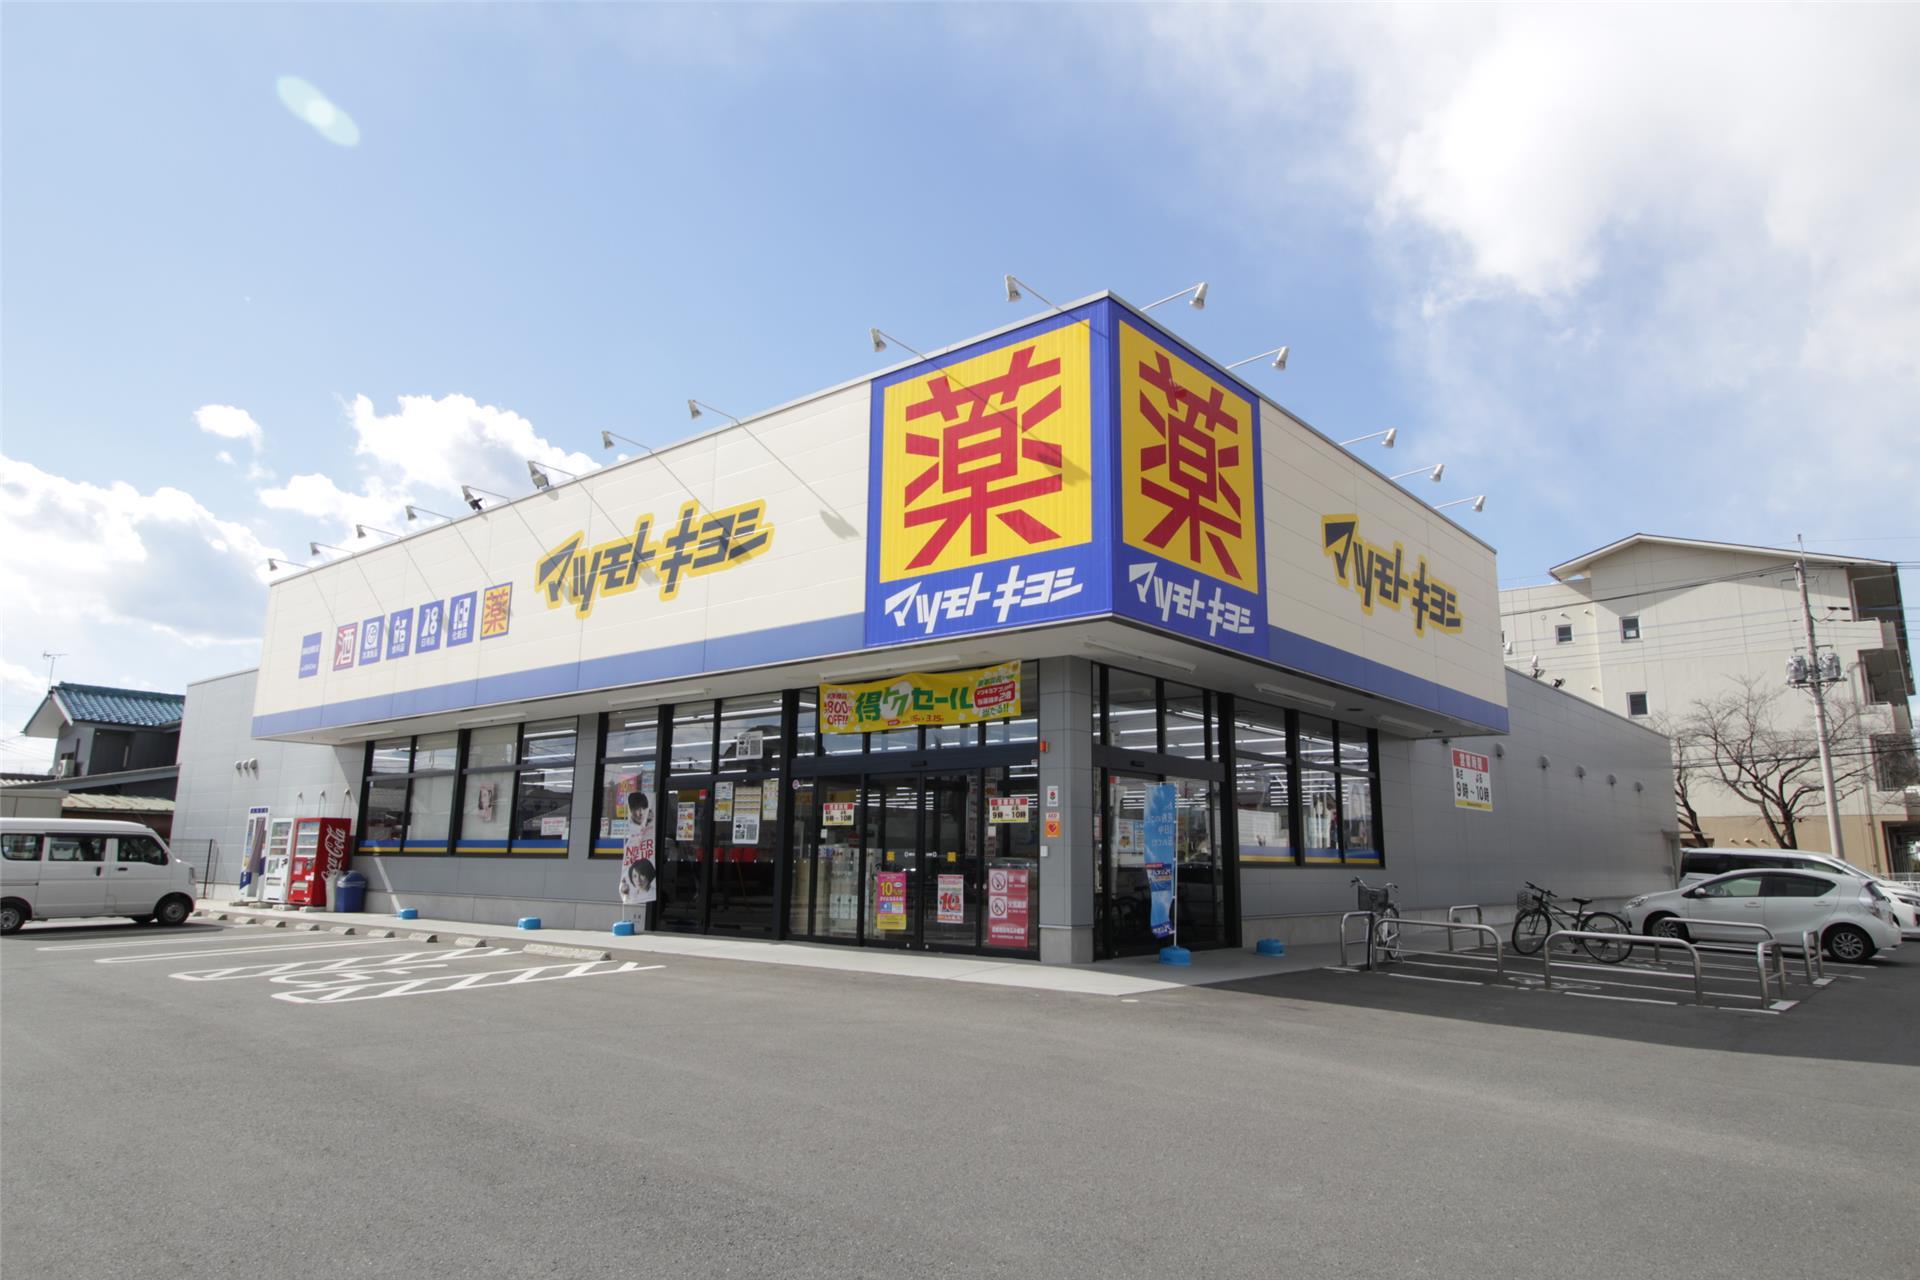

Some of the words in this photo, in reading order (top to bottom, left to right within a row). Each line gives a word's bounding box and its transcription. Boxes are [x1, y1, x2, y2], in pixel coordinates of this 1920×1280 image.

[904, 345, 1062, 571] 薬
[1138, 350, 1242, 580] 薬
[538, 505, 769, 612] マツモトキヨシ
[885, 565, 1083, 633] マツモトキヨシ
[1128, 562, 1255, 637] マツモトキヨシ
[1324, 520, 1461, 631] マツモトキヨシ
[336, 628, 355, 666] 酒
[483, 589, 508, 634] 薬
